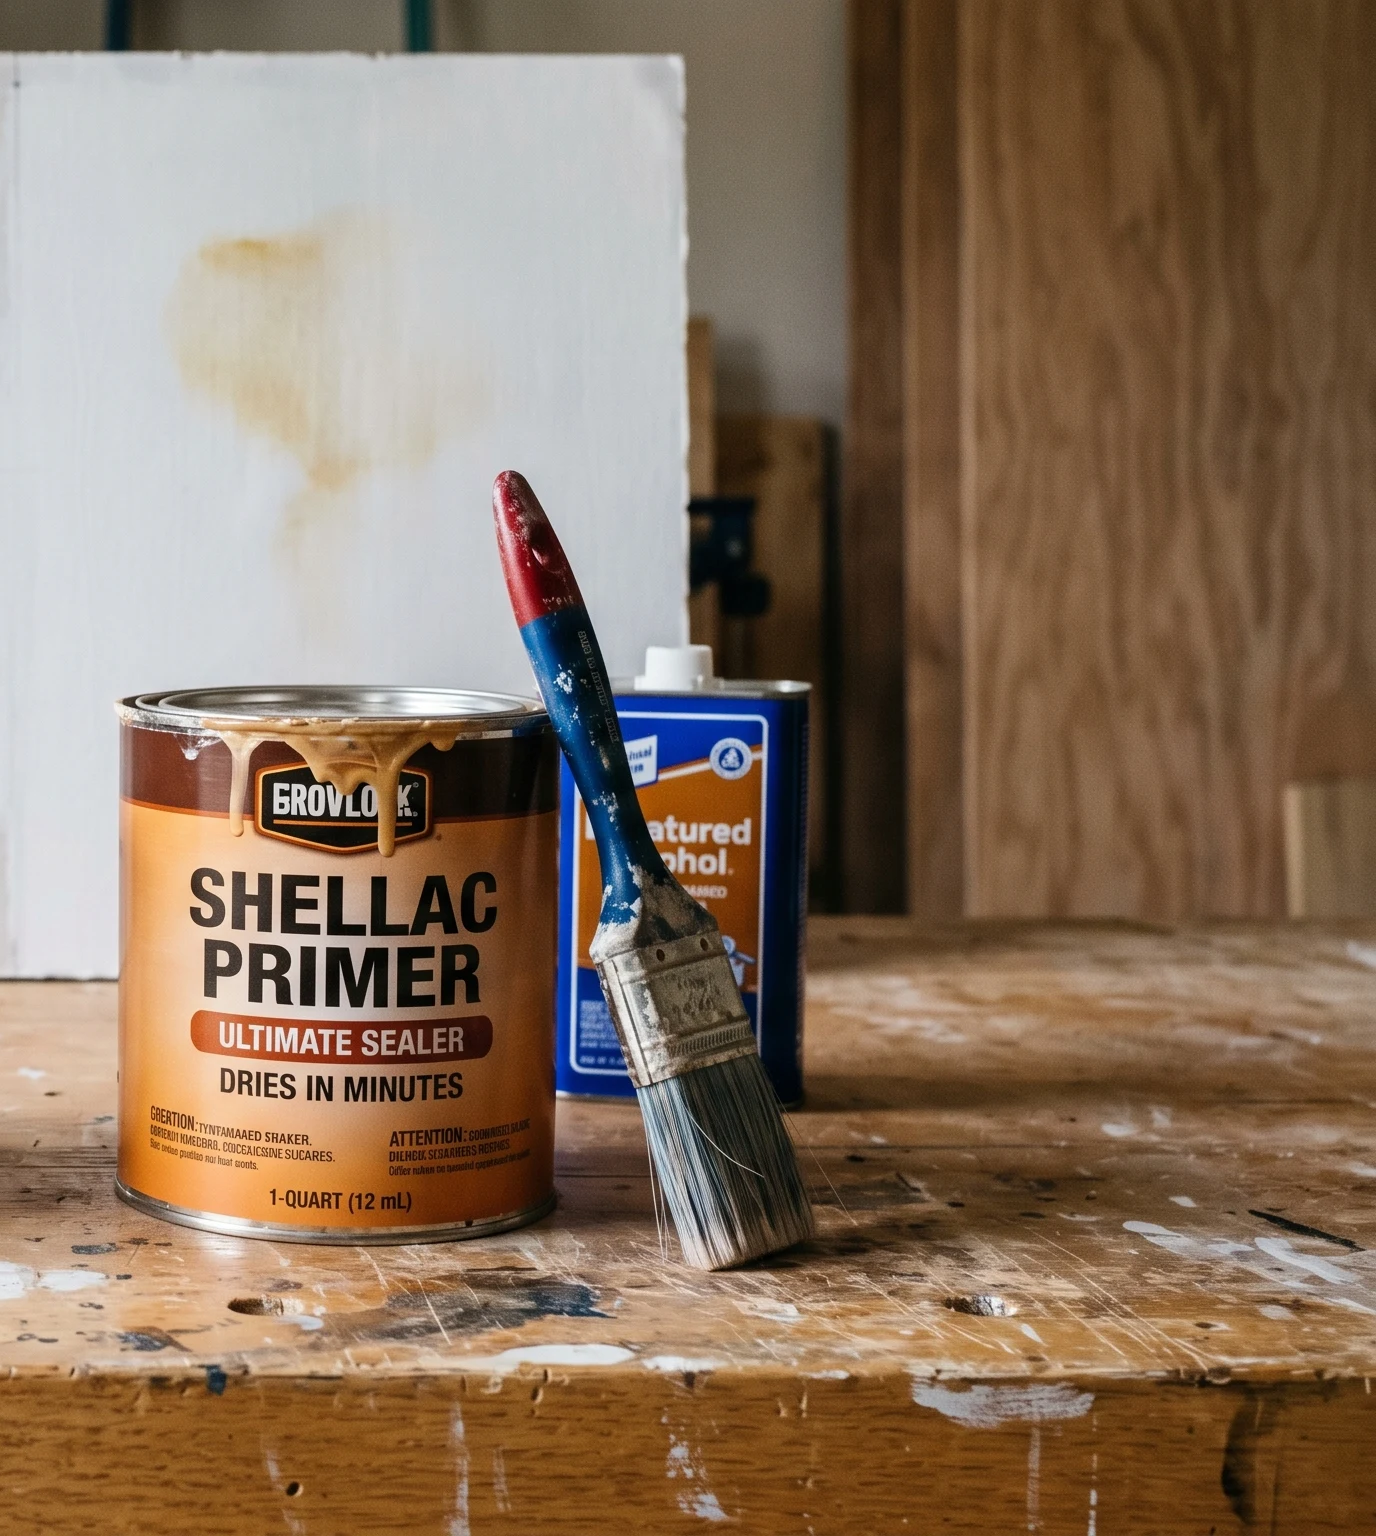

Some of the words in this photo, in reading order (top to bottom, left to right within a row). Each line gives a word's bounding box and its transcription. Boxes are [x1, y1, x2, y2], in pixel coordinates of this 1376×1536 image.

[273, 782, 413, 818] BROVLOK
[190, 867, 498, 937] SHELLAC
[203, 939, 482, 1009] PRIMER
[219, 1021, 353, 1056] ULTIMATE
[361, 1024, 465, 1056] SEALER
[220, 1067, 297, 1100] DRIES
[306, 1072, 334, 1102] IN
[343, 1070, 464, 1103] MINUTES
[389, 1126, 468, 1147] ATTENTION:
[269, 1188, 344, 1210] 1-QUART
[348, 1191, 375, 1215] (12
[380, 1188, 412, 1212] mL)
